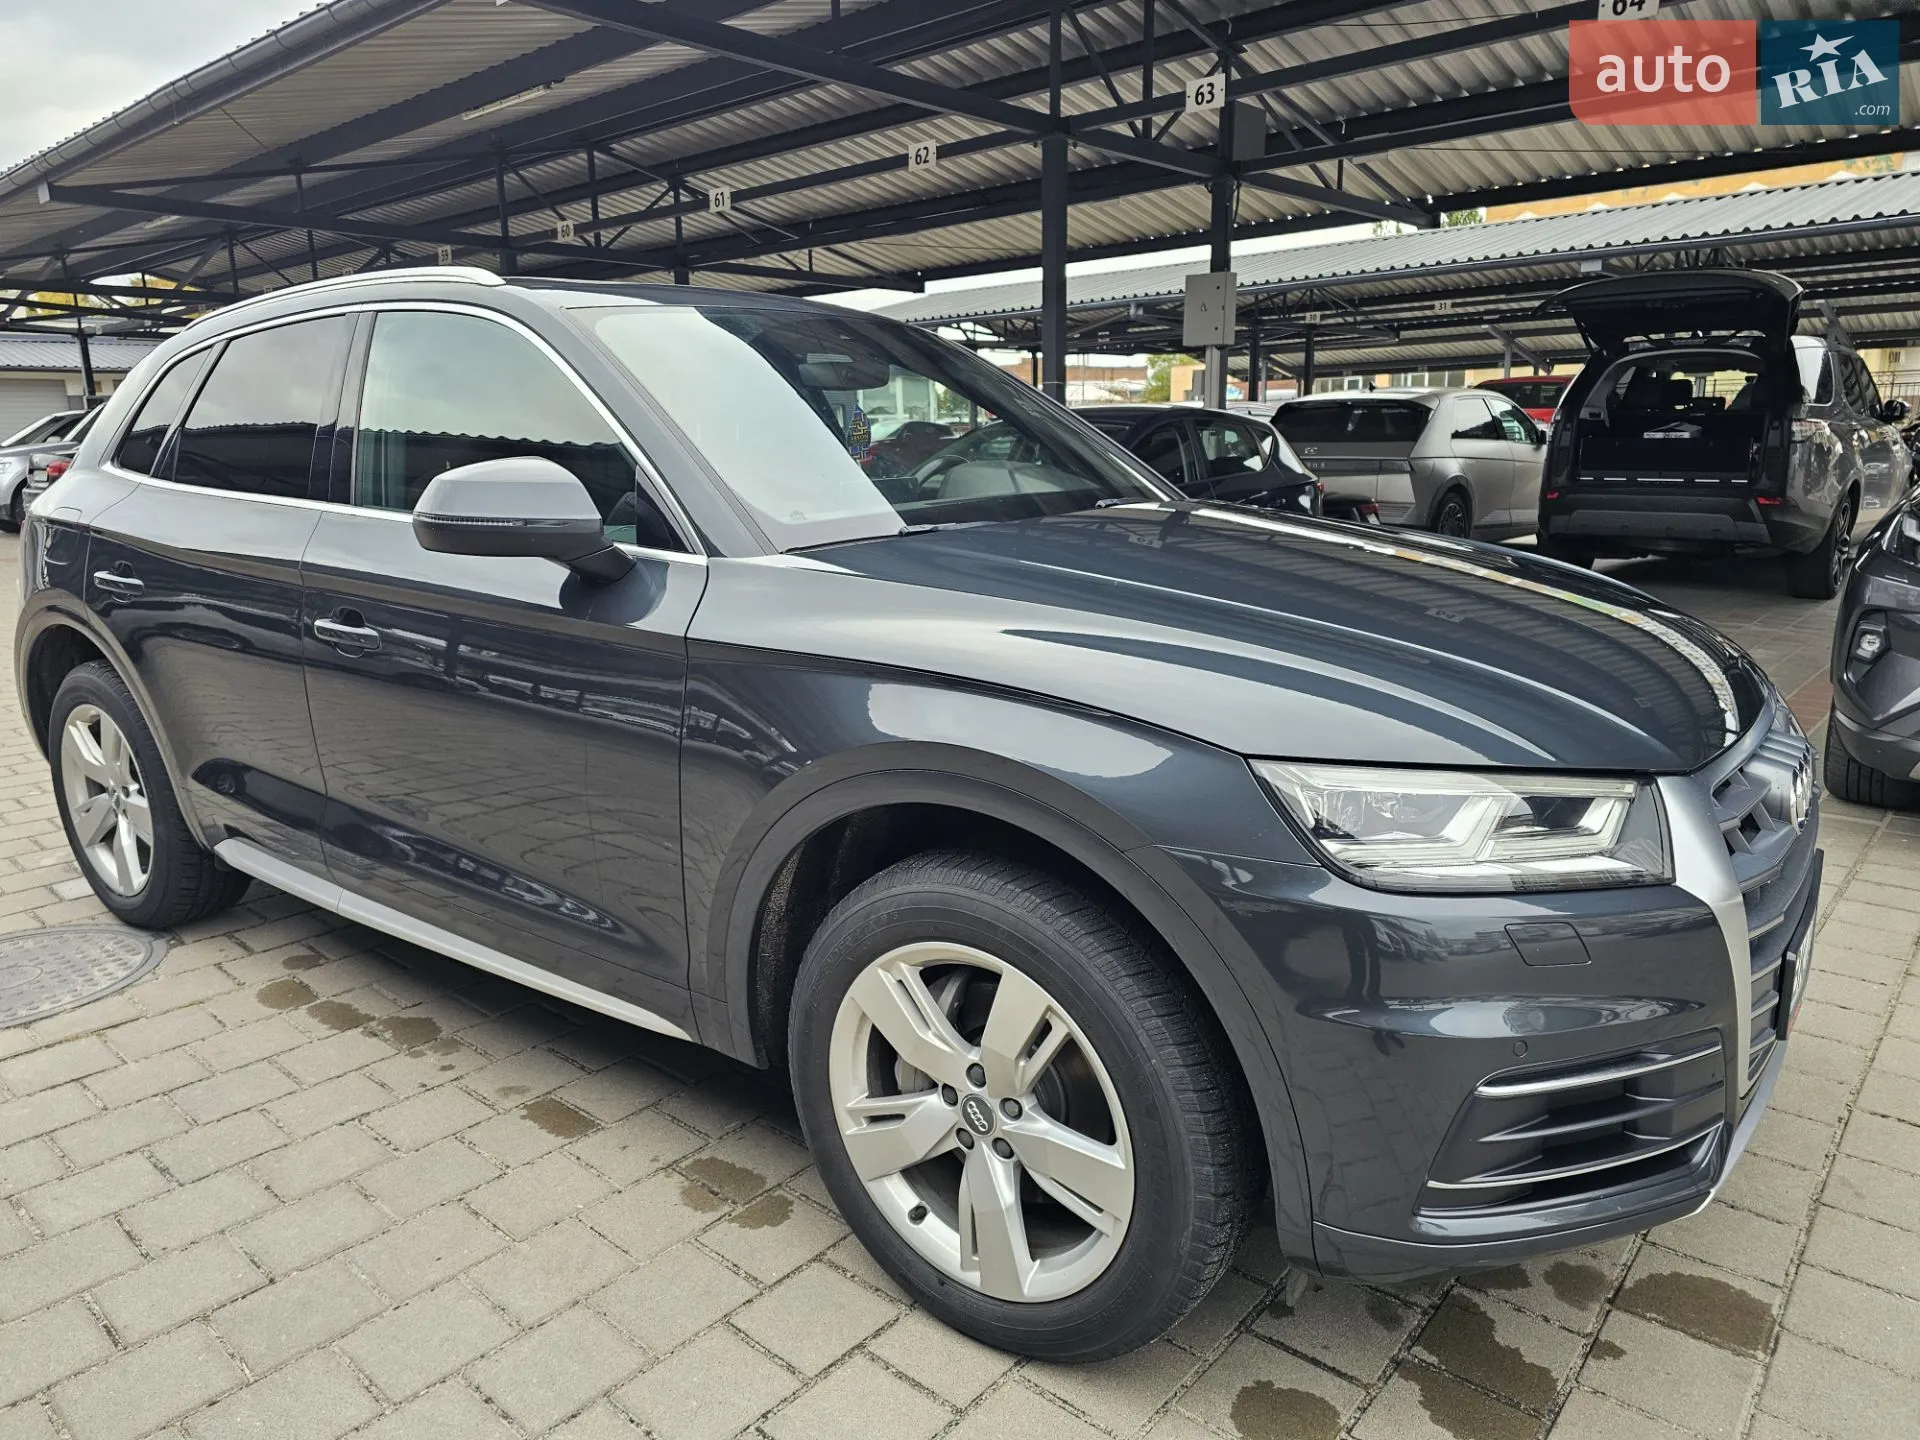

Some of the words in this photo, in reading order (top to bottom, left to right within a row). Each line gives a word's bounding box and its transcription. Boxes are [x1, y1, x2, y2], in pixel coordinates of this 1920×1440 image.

[1194, 82, 1215, 106] 63
[915, 146, 930, 166] 62
[715, 191, 725, 208] 61
[561, 224, 571, 238] 60
[441, 249, 449, 262] 59
[1438, 302, 1447, 311] 31
